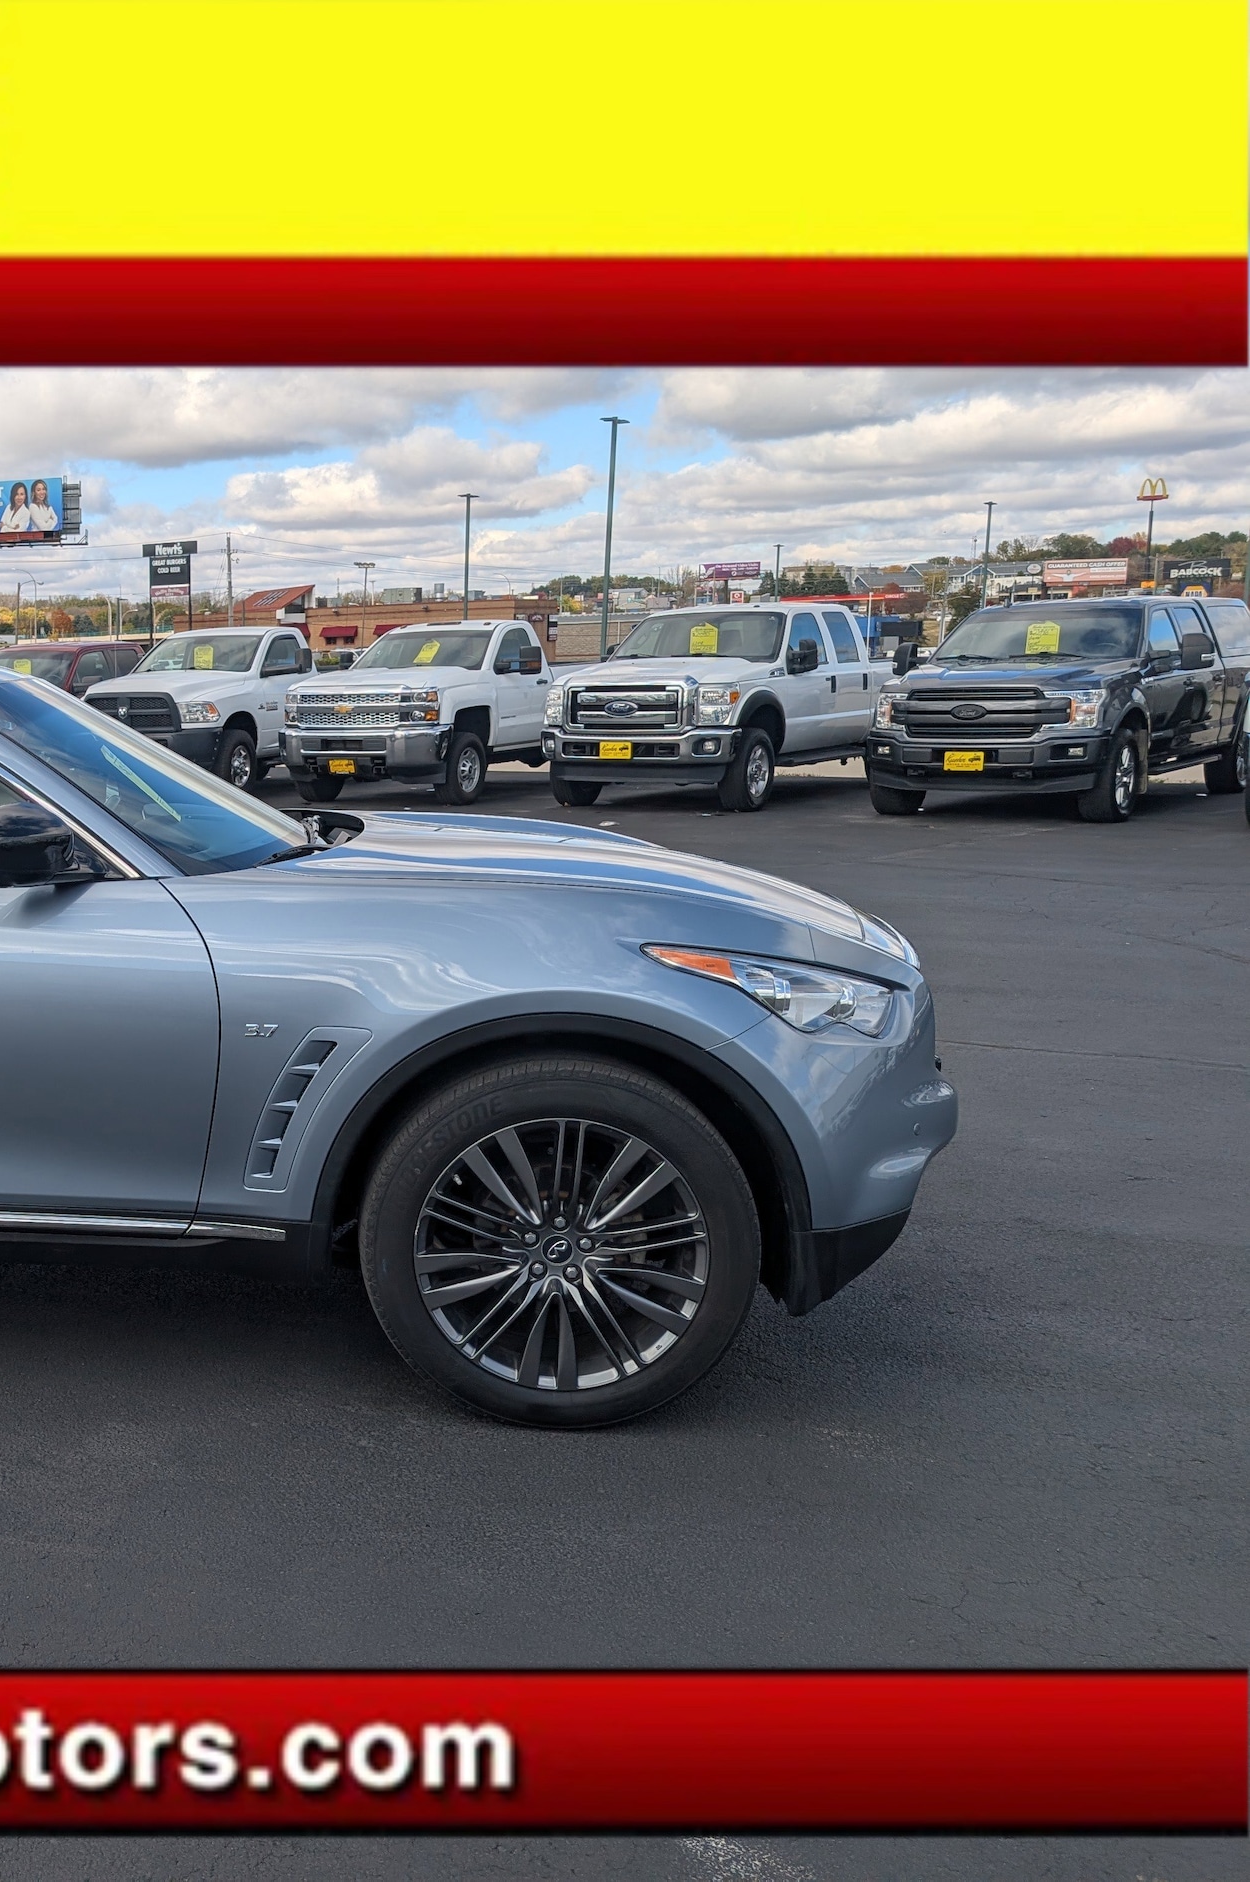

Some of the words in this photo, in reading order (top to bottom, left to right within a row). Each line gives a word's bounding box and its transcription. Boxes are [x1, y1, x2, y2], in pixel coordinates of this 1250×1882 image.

[154, 543, 183, 556] Newt's
[166, 558, 187, 566] BURGERS
[1170, 566, 1223, 578] BABCOCK
[959, 708, 977, 717] Ford
[946, 753, 966, 763] Kuehn
[244, 1023, 279, 1038] 3.7
